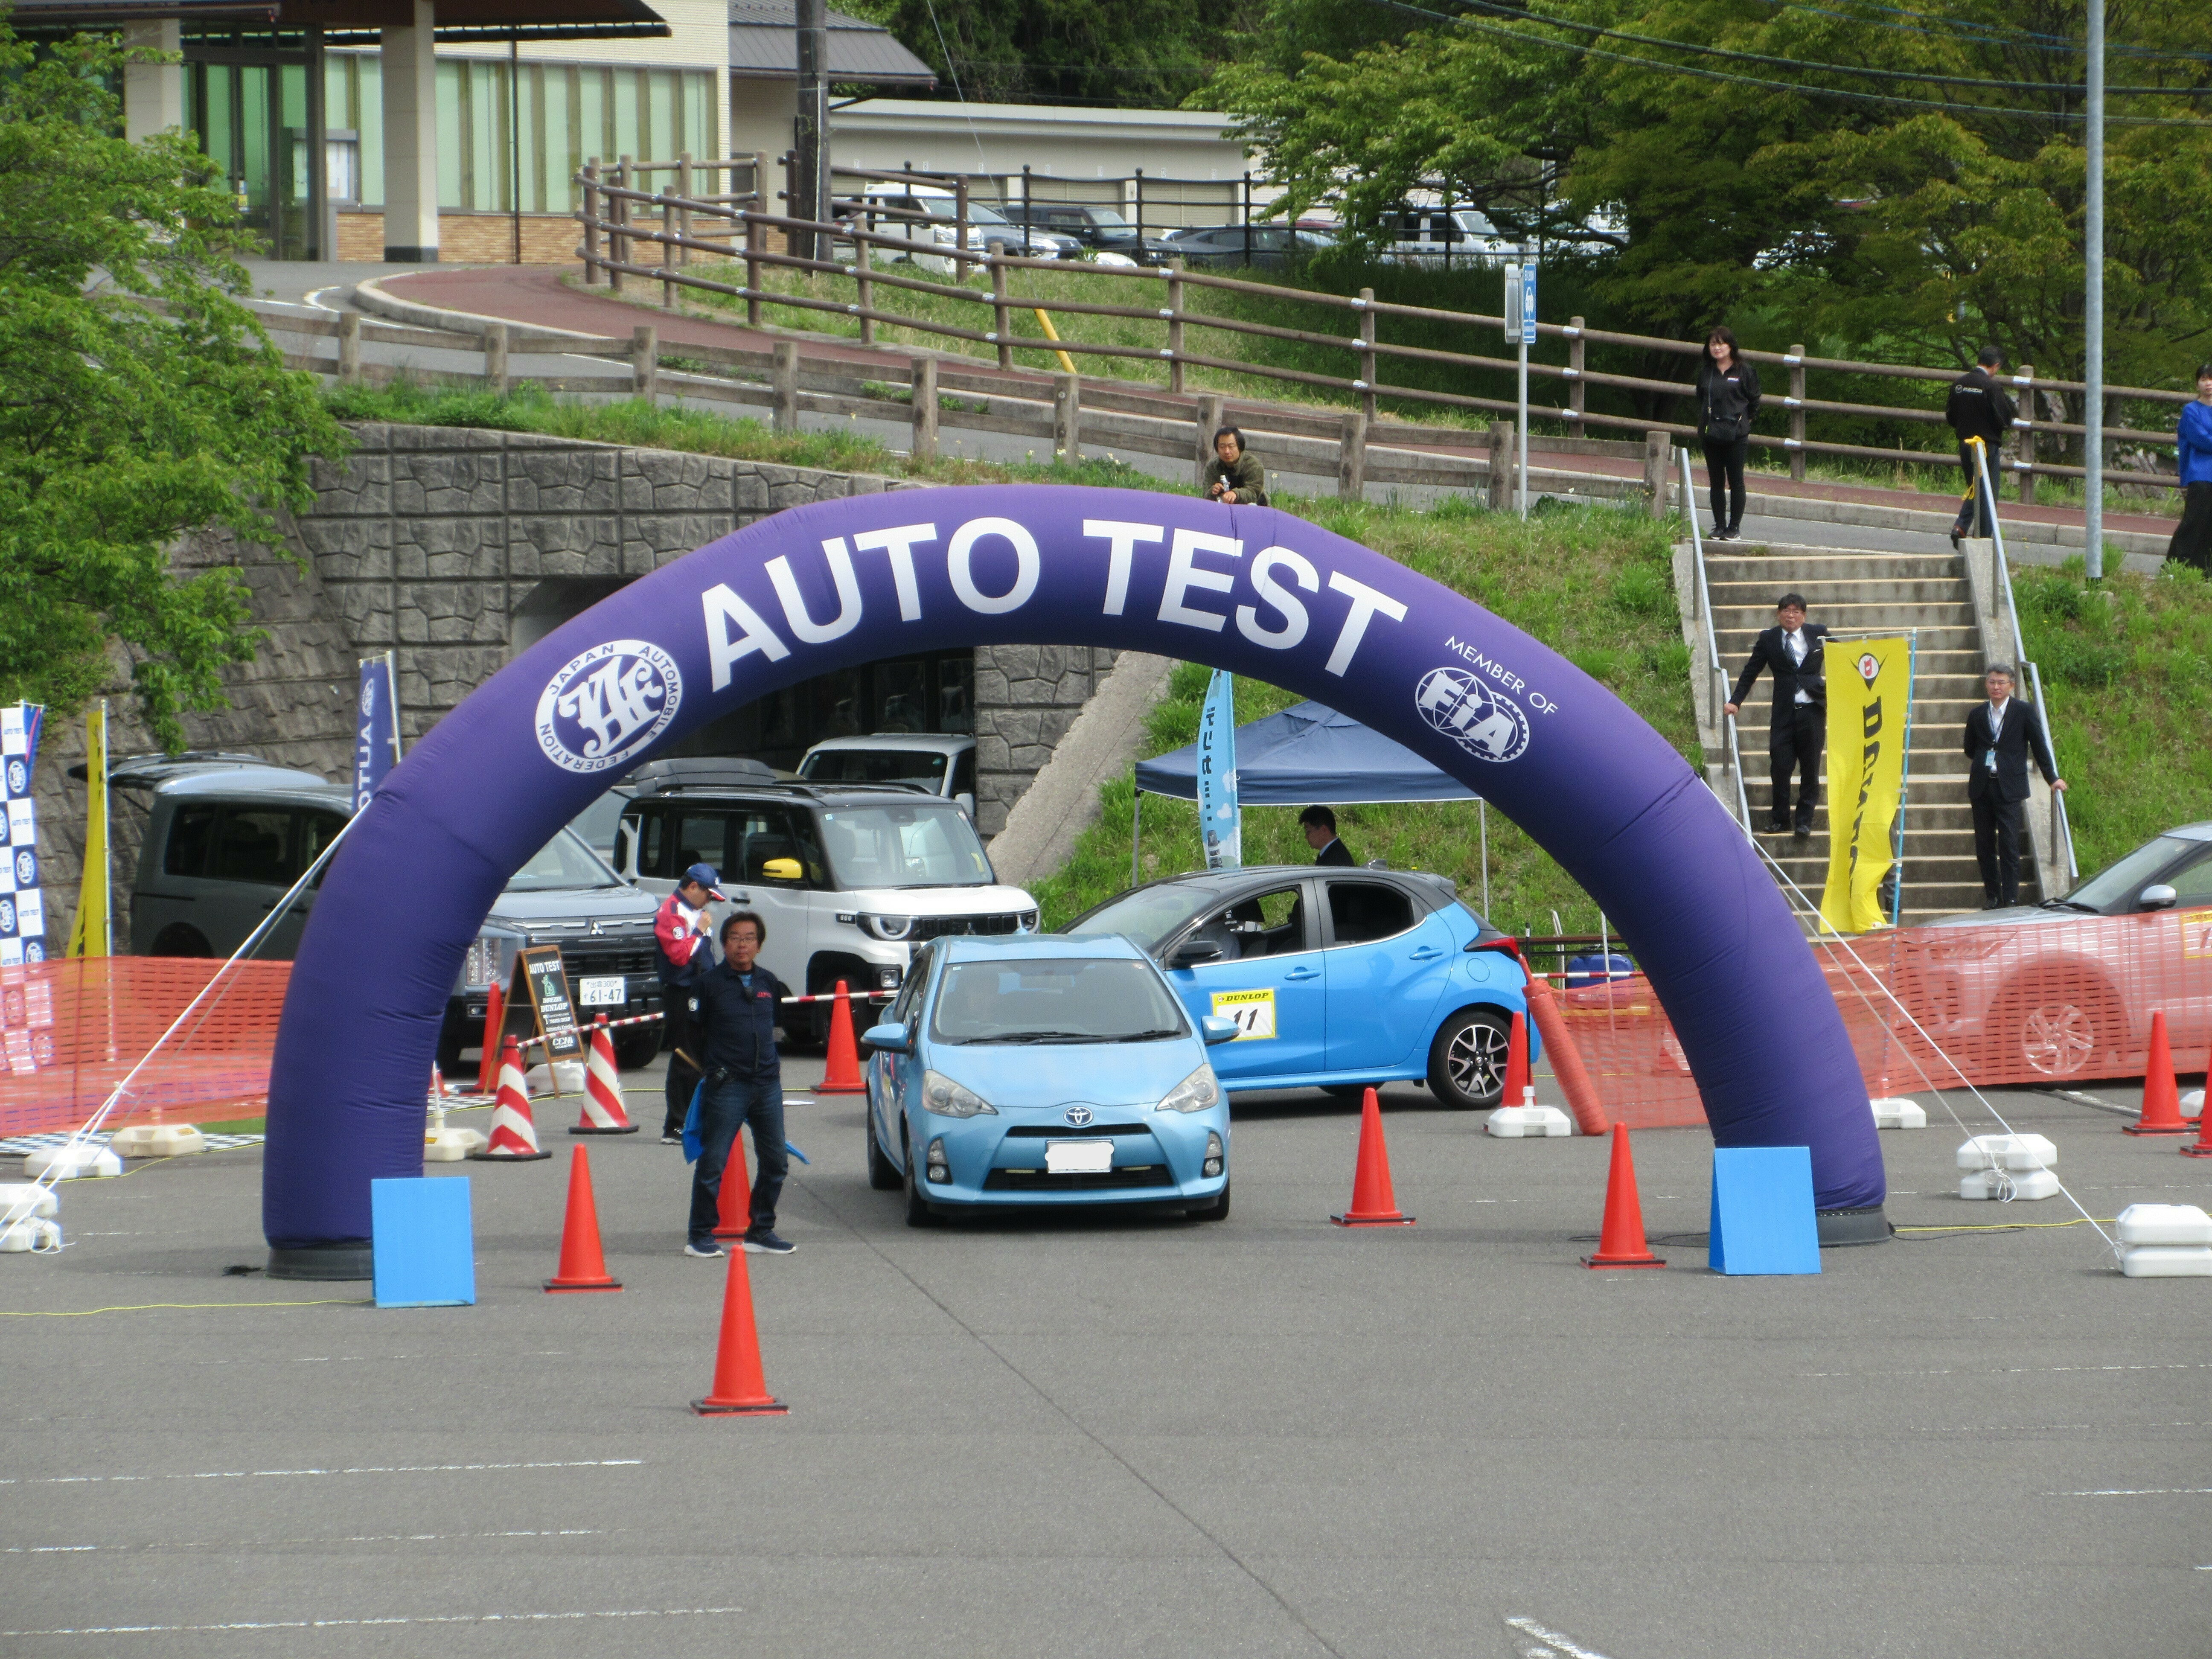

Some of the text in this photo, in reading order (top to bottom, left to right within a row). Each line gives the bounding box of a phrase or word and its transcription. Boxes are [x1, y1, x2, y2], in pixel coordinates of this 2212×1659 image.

[702, 516, 1409, 692] AUTO TEST
[1444, 635, 1558, 715] MEMBER OF
[540, 643, 678, 771] JAPAN AUTOMOBILE FEDERATION
[529, 960, 560, 974] AUTO TEST
[590, 989, 621, 1002] 61-47
[1226, 992, 1269, 1001] DUNLOP
[540, 1002, 568, 1013] DUNLOP
[1234, 1008, 1258, 1031] 11
